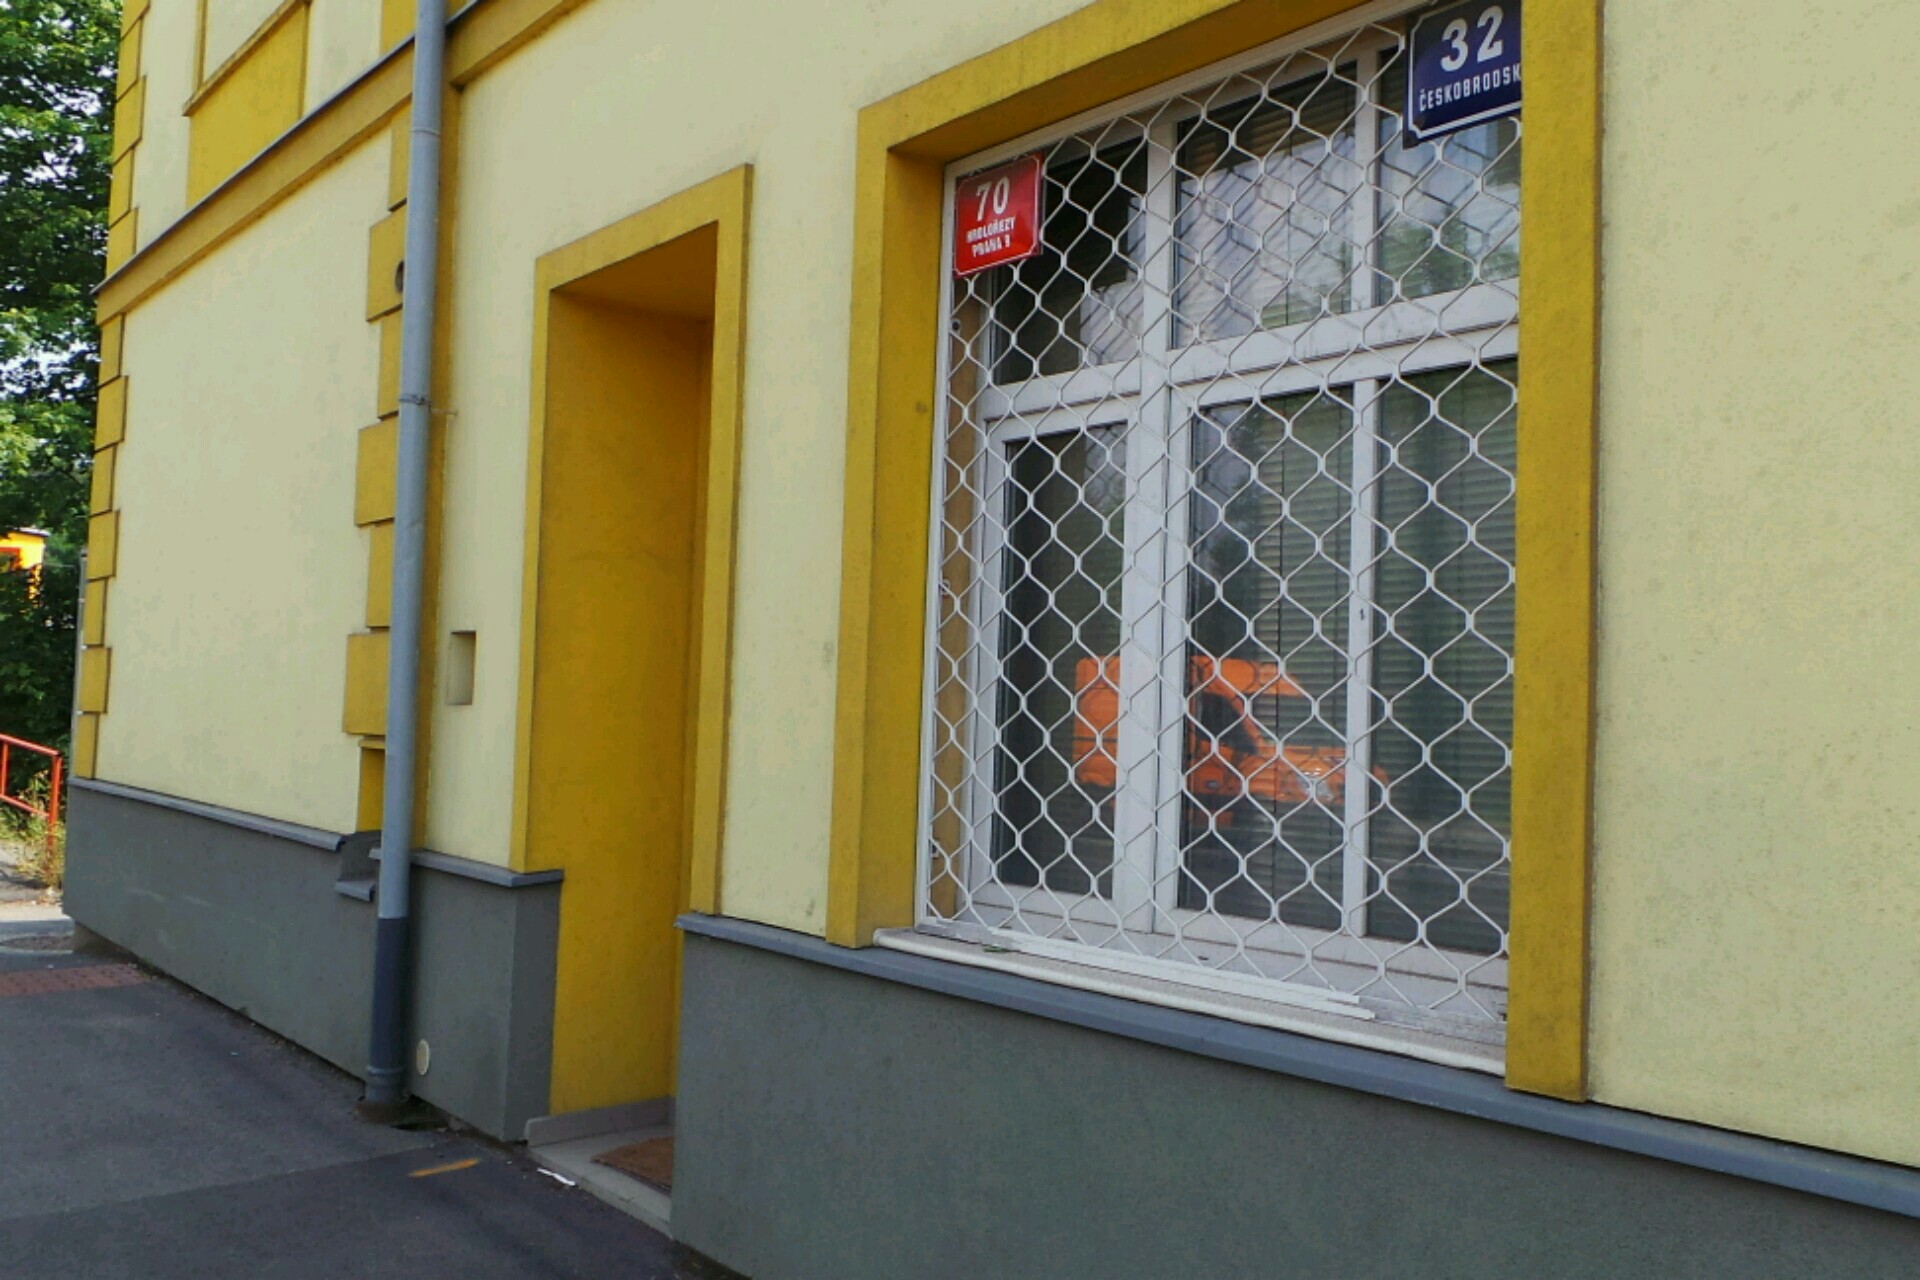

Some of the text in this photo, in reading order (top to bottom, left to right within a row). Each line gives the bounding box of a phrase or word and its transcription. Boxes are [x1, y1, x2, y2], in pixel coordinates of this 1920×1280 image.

[1441, 5, 1504, 72] 32
[1419, 62, 1521, 112] ČESKOBRODSK
[976, 176, 1010, 222] 70
